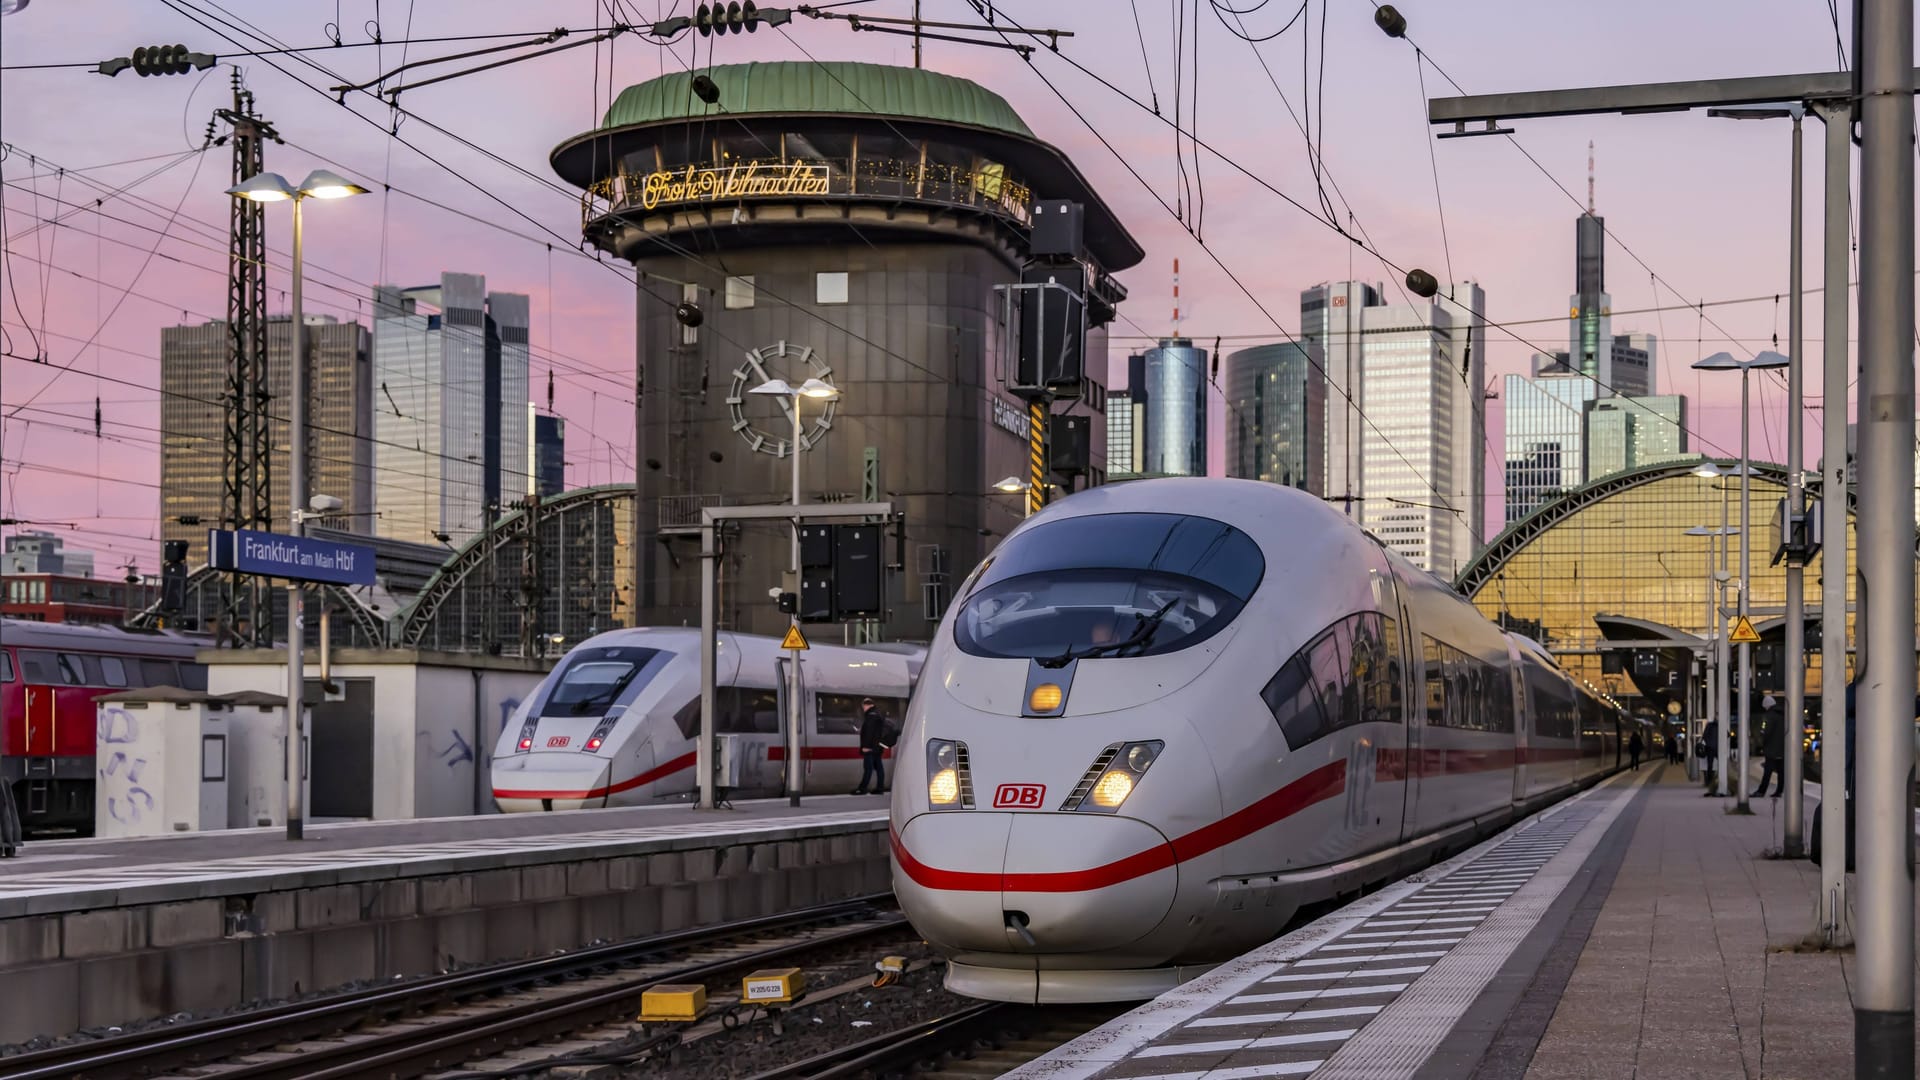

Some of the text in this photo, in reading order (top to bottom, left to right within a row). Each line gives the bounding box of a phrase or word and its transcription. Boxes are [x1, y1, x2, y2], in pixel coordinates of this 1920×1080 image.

[643, 160, 828, 209] Frohe Weihnachten
[245, 537, 354, 571] Frankfurt am Main Hbf
[1668, 671, 1677, 685] F
[998, 787, 1040, 805] DB
